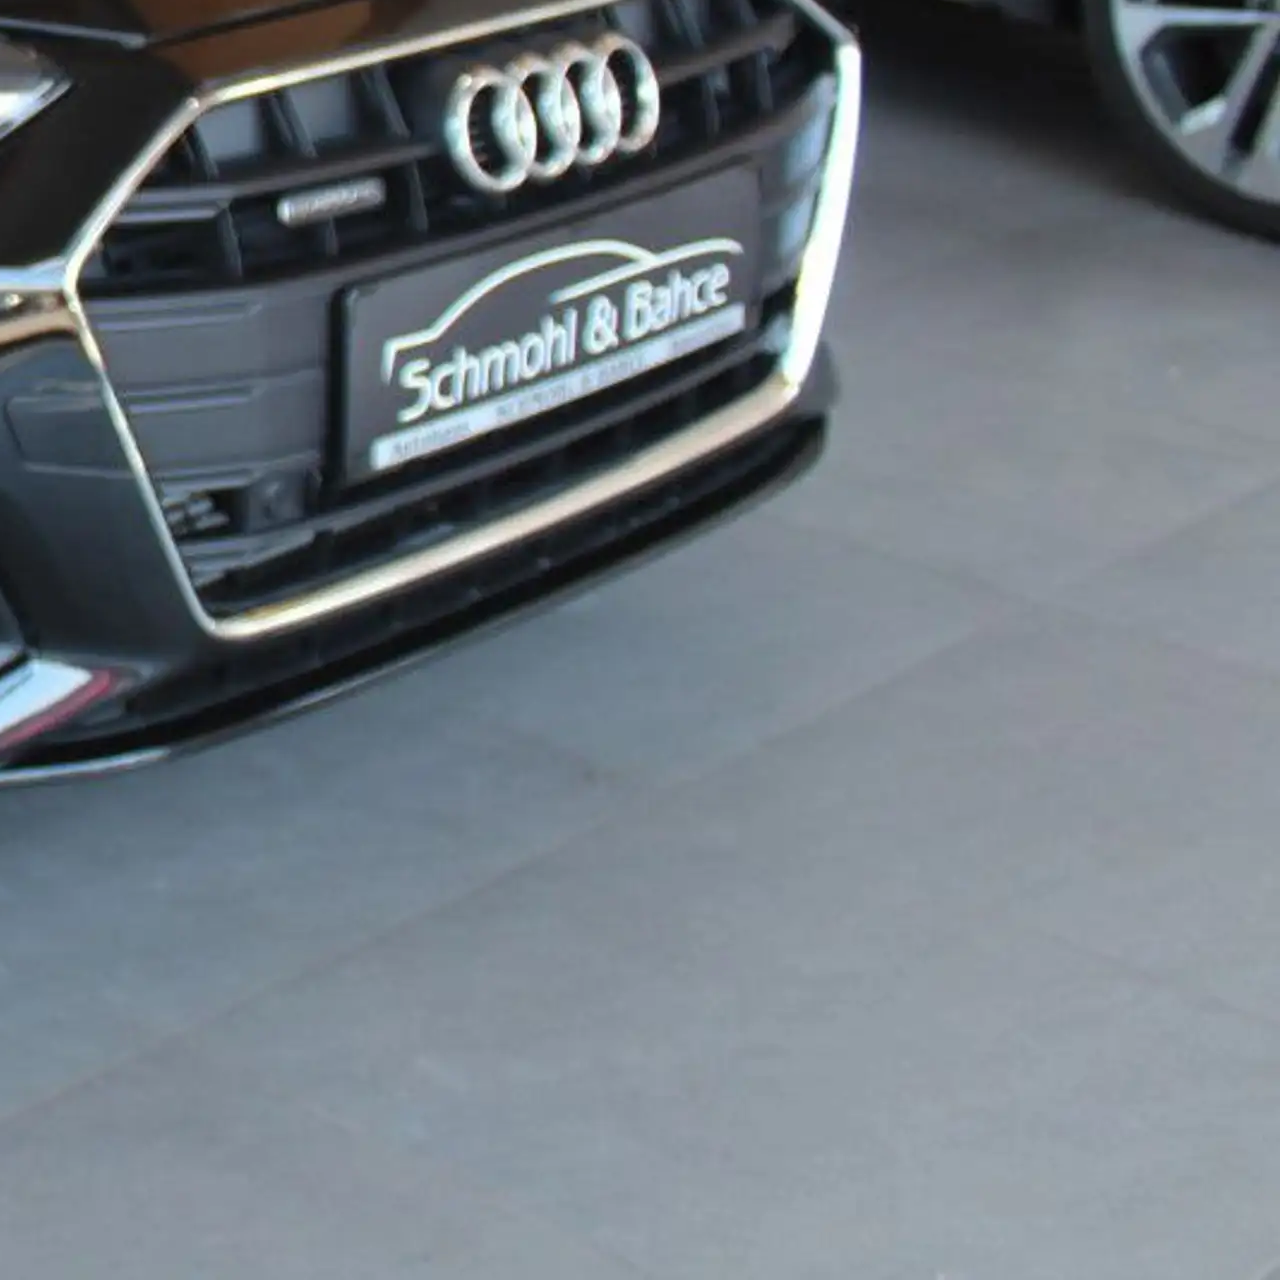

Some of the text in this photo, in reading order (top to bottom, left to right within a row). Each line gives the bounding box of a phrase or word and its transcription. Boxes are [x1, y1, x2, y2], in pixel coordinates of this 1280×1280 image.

[397, 306, 577, 423] Schmohl
[582, 294, 619, 355] &
[623, 262, 729, 341] Bahce
